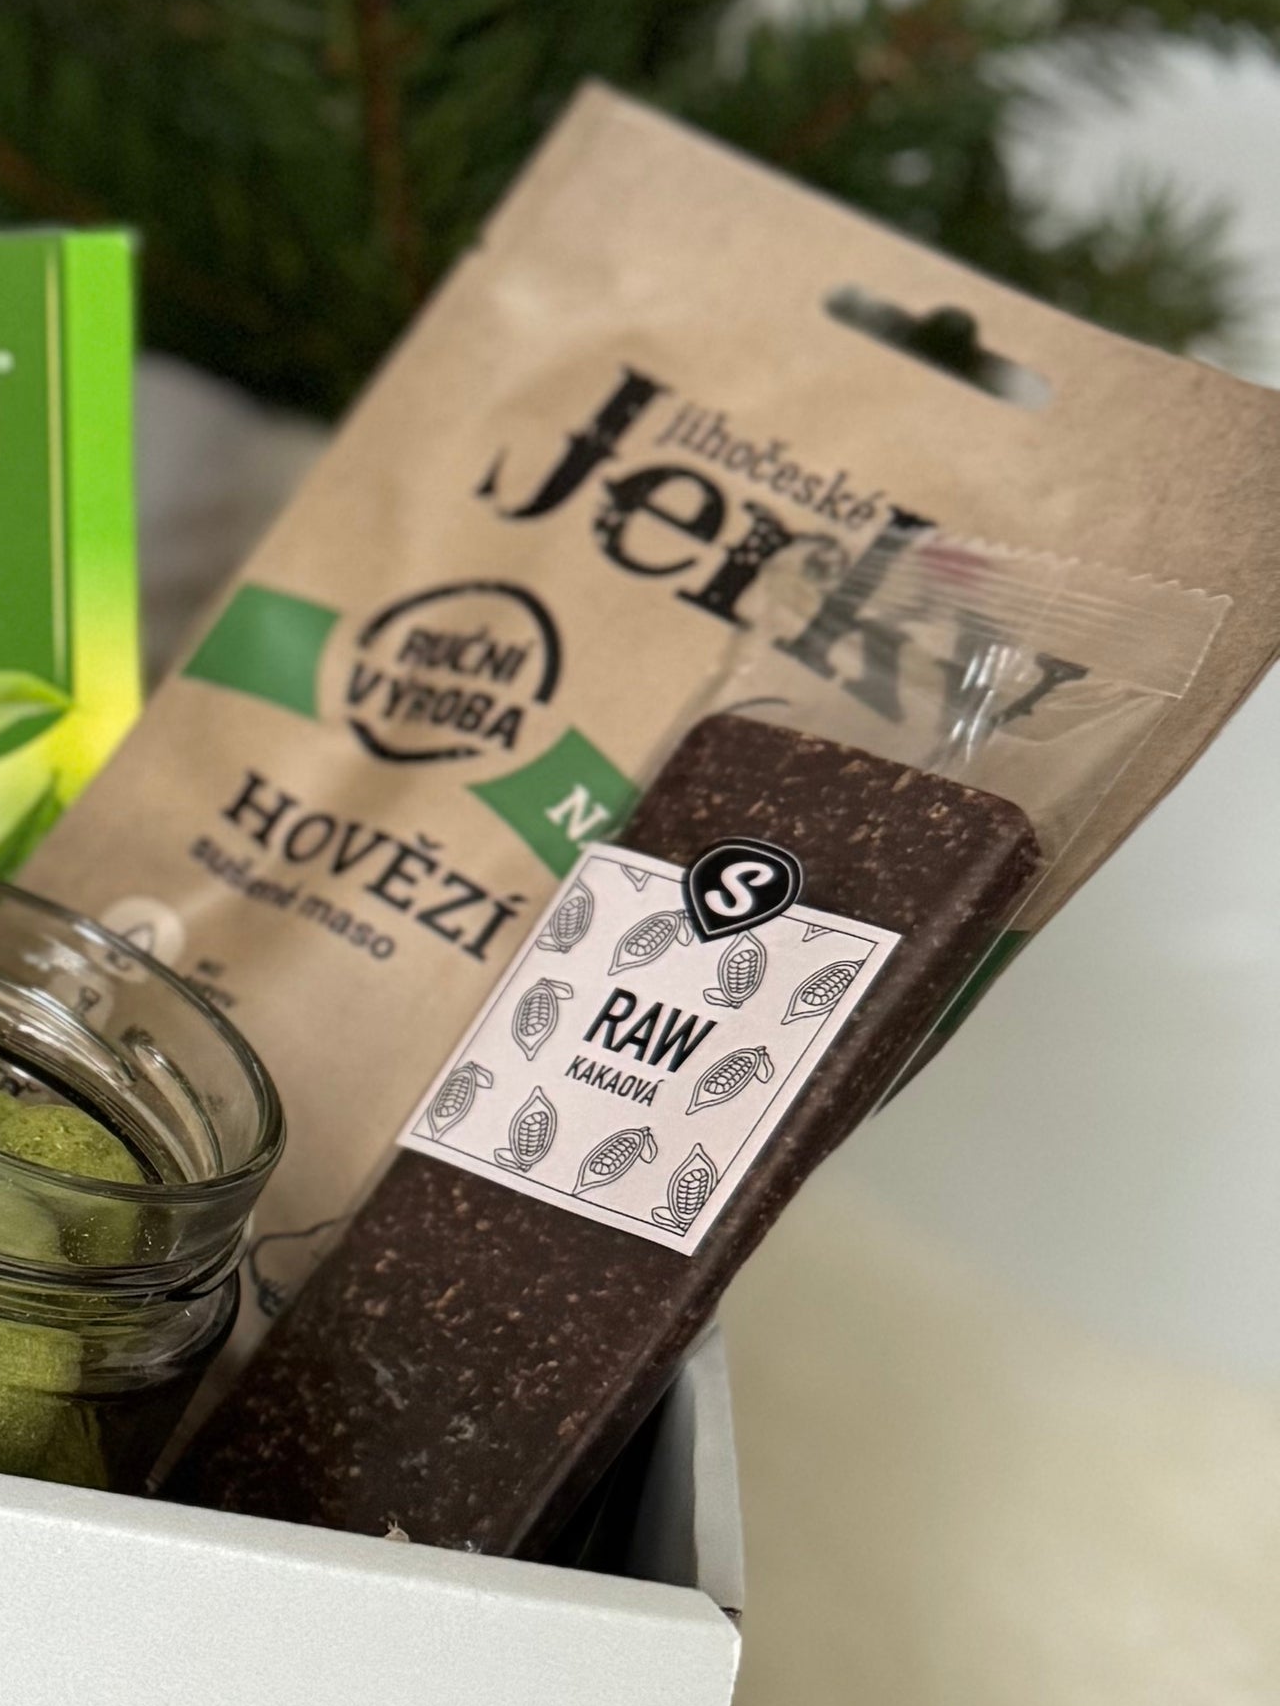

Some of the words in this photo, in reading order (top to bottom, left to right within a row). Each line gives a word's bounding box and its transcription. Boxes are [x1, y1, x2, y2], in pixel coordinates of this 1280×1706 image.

[221, 770, 528, 963] HOVĚZÍ
[583, 987, 718, 1074] RAW
[563, 1054, 667, 1109] KAKAOVÁ
